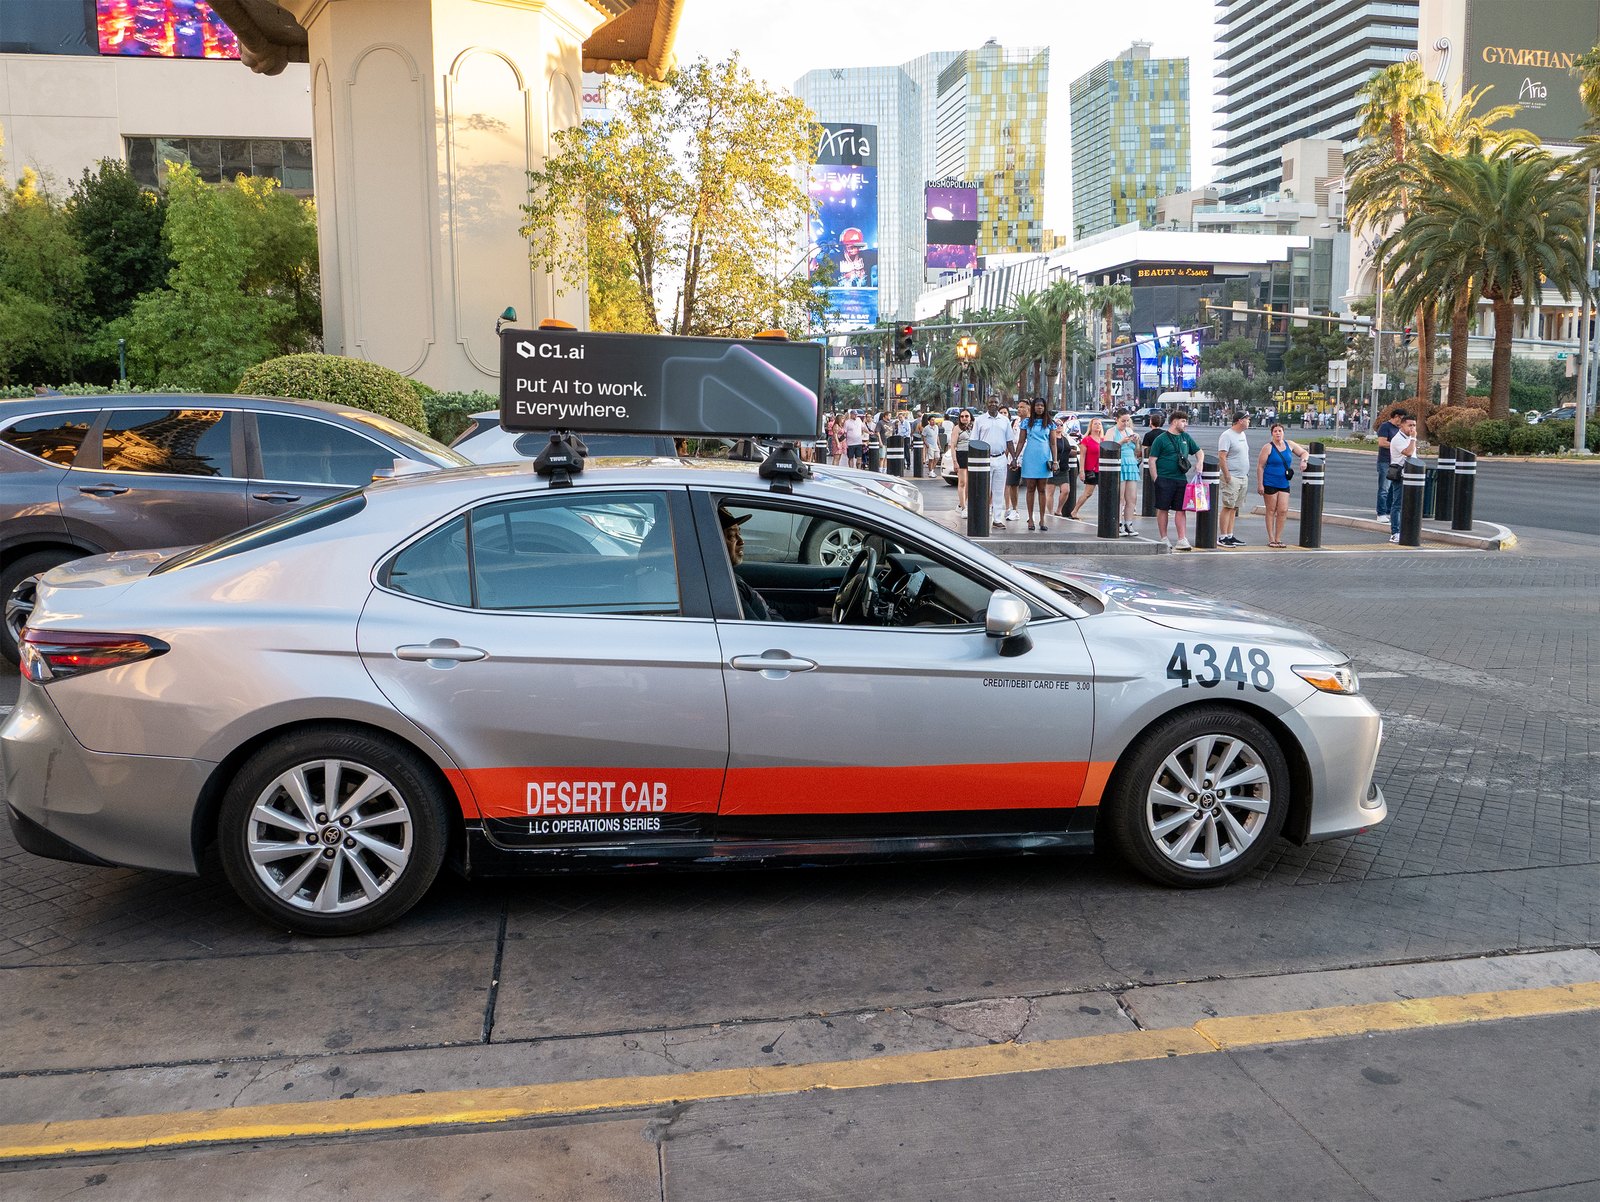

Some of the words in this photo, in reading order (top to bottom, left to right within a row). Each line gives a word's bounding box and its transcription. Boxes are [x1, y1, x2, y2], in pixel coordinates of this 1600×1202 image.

[1518, 77, 1548, 100] Aria
[817, 128, 871, 157] Aria
[819, 172, 869, 184] JEWEL
[1138, 269, 1176, 277] BEAUTY
[1185, 268, 1209, 277] Essex
[539, 343, 585, 360] C1.ai
[839, 346, 858, 356] Aria
[516, 378, 548, 393] Put
[552, 380, 568, 394] AI
[573, 380, 593, 395] to
[598, 381, 647, 397] work.
[516, 400, 630, 420] Everywhere.
[1166, 642, 1275, 693] 4348
[983, 678, 1032, 689] CREDIT/DEBIT
[1034, 680, 1054, 689] CARD
[1056, 681, 1069, 690] FEE
[1077, 682, 1091, 690] 3.00
[526, 781, 616, 815] DESERT
[621, 781, 668, 812] CAB
[528, 820, 549, 834] LLC
[551, 818, 620, 833] OPERATIONS
[622, 817, 661, 831] SERIES
